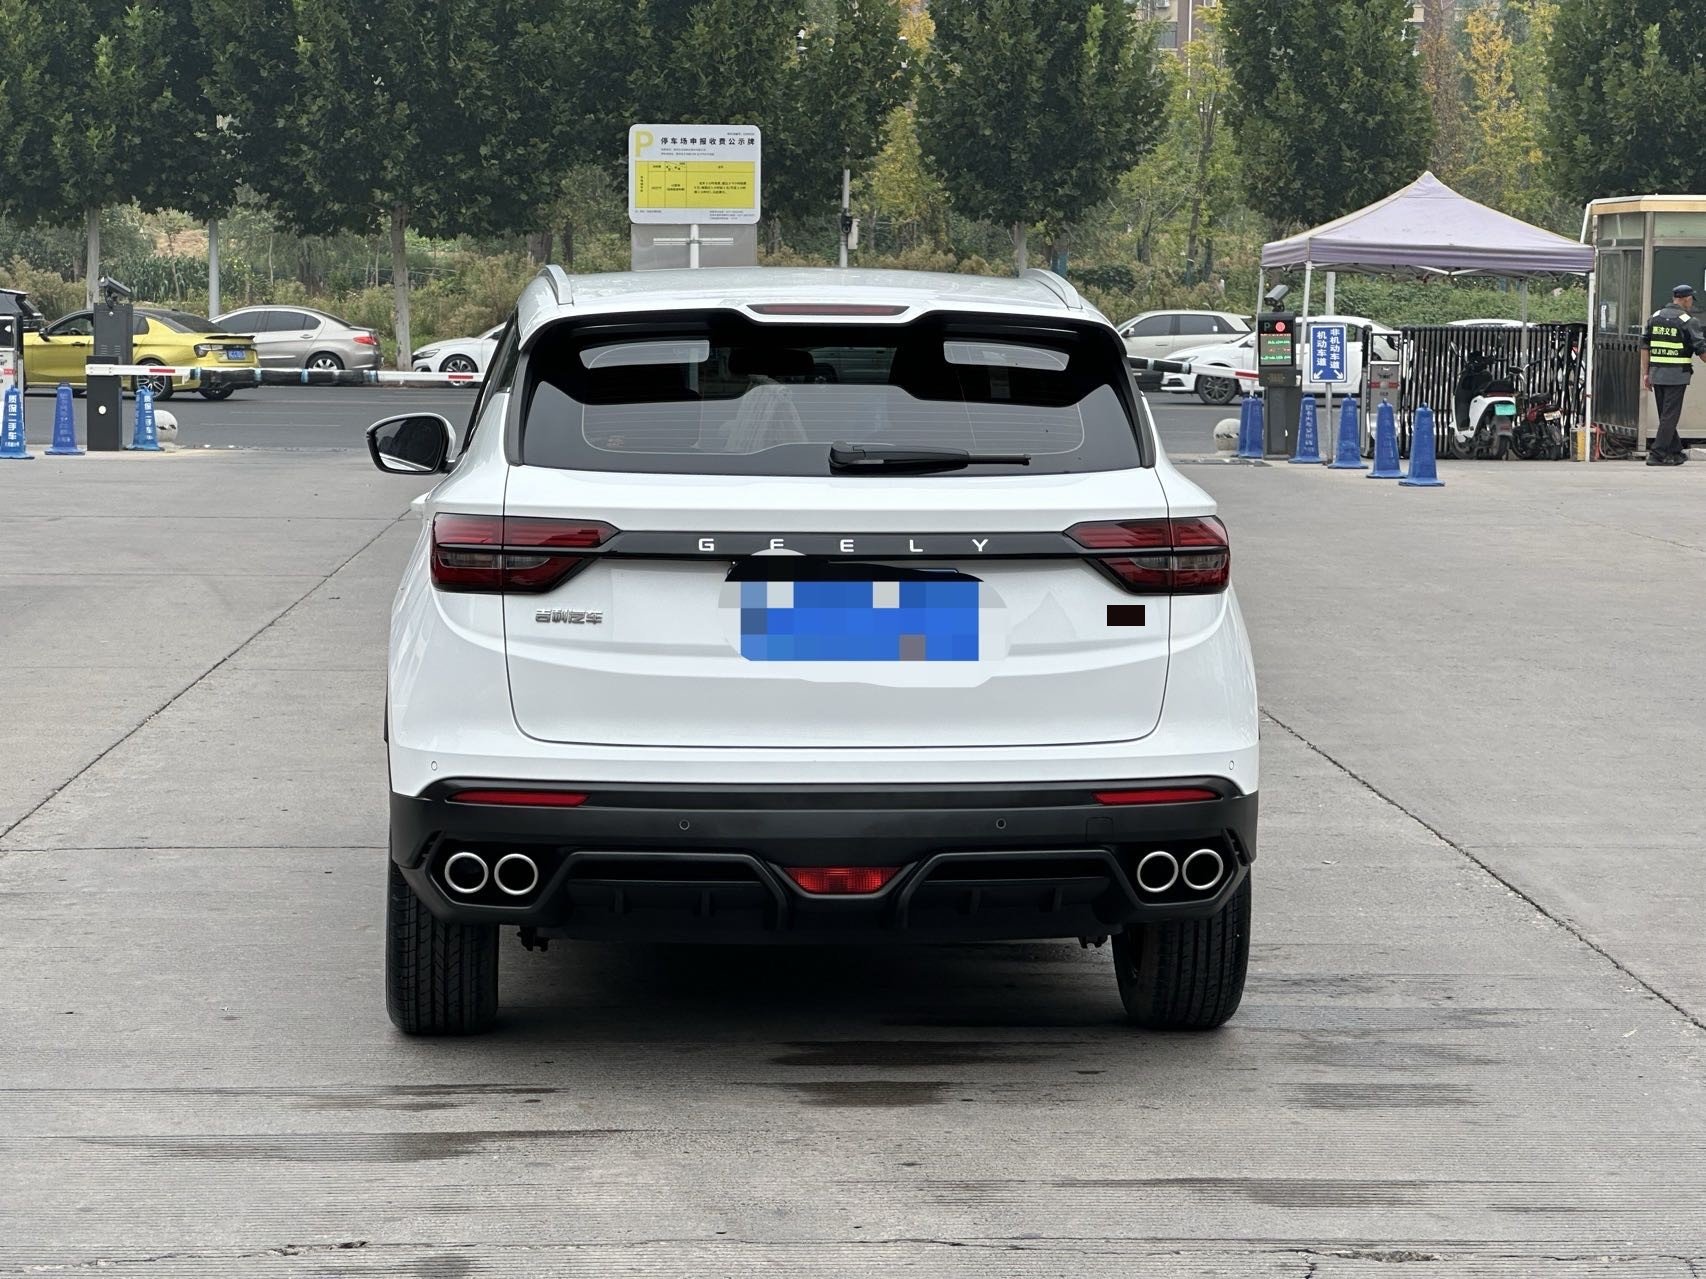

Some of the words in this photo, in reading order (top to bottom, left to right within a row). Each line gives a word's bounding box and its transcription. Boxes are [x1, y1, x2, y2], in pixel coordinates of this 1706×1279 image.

[635, 131, 653, 157] P
[661, 137, 755, 146] 停车场申报收费公示牌
[1317, 331, 1327, 366] 机动车道
[1330, 329, 1340, 368] 非机动车道
[8, 394, 17, 440] 质保二手车
[143, 395, 153, 434] 质保二手车
[698, 538, 989, 553] GEELY
[535, 608, 603, 625] 吉利汽车
